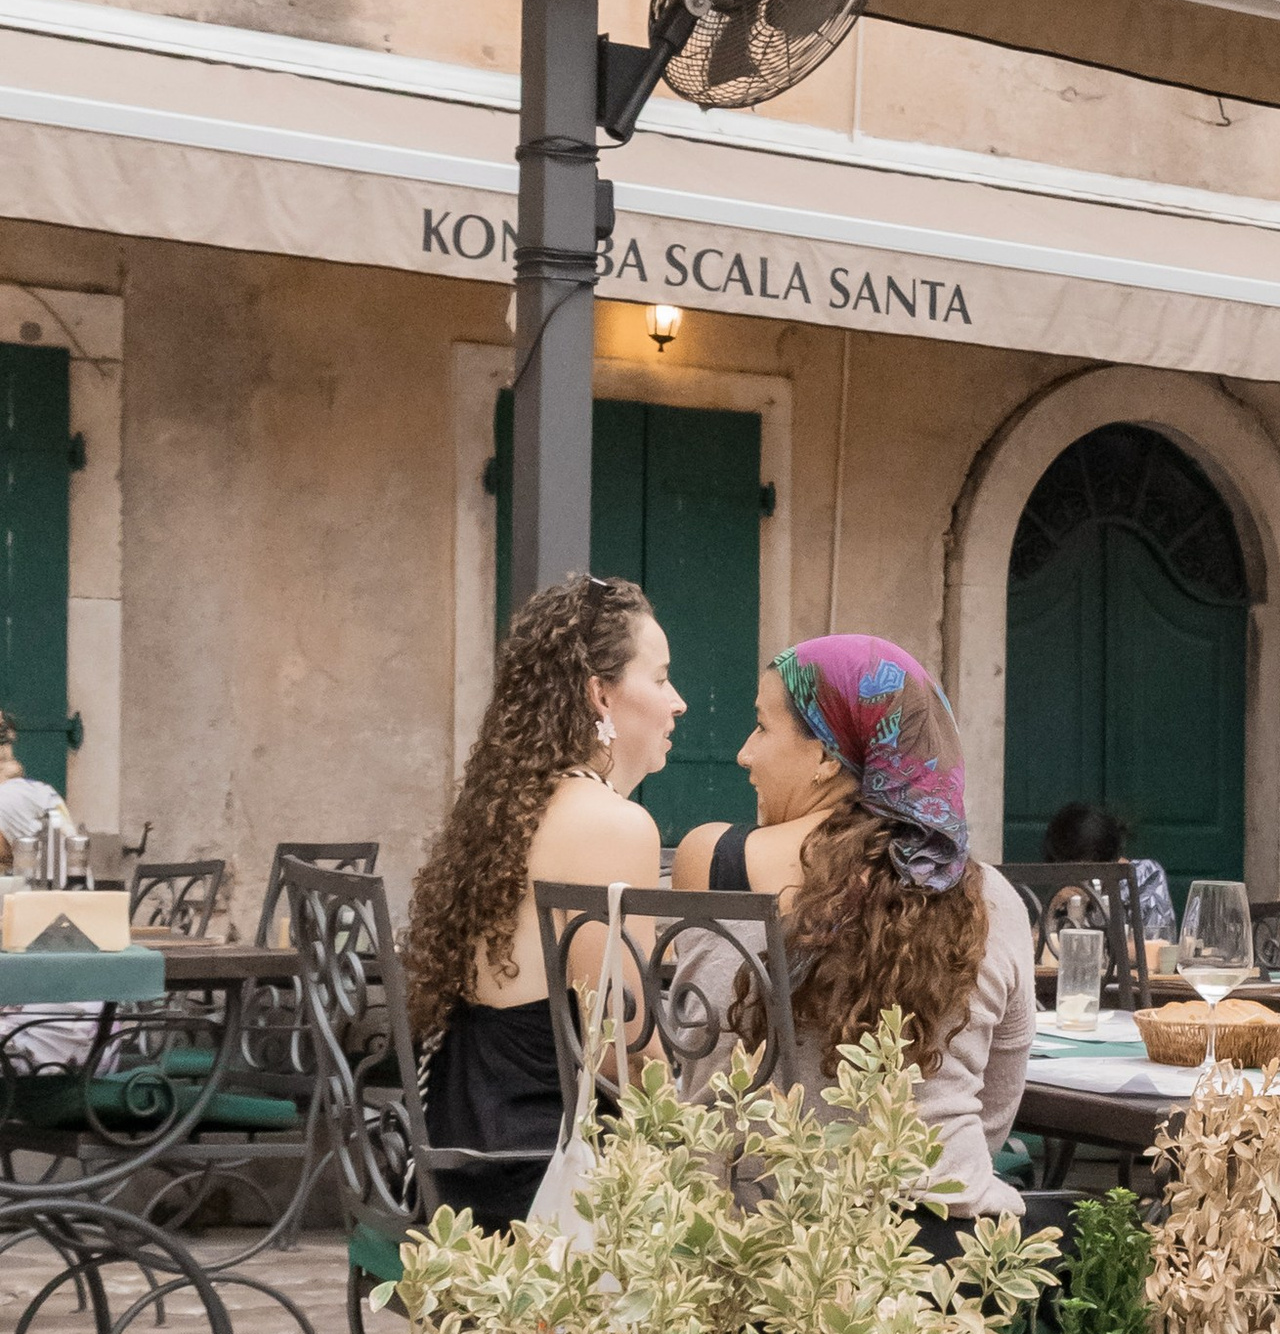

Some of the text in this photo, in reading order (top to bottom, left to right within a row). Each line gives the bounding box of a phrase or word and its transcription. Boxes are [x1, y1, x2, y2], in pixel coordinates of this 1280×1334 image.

[422, 208, 973, 325] KONBA SCALA SANTA
